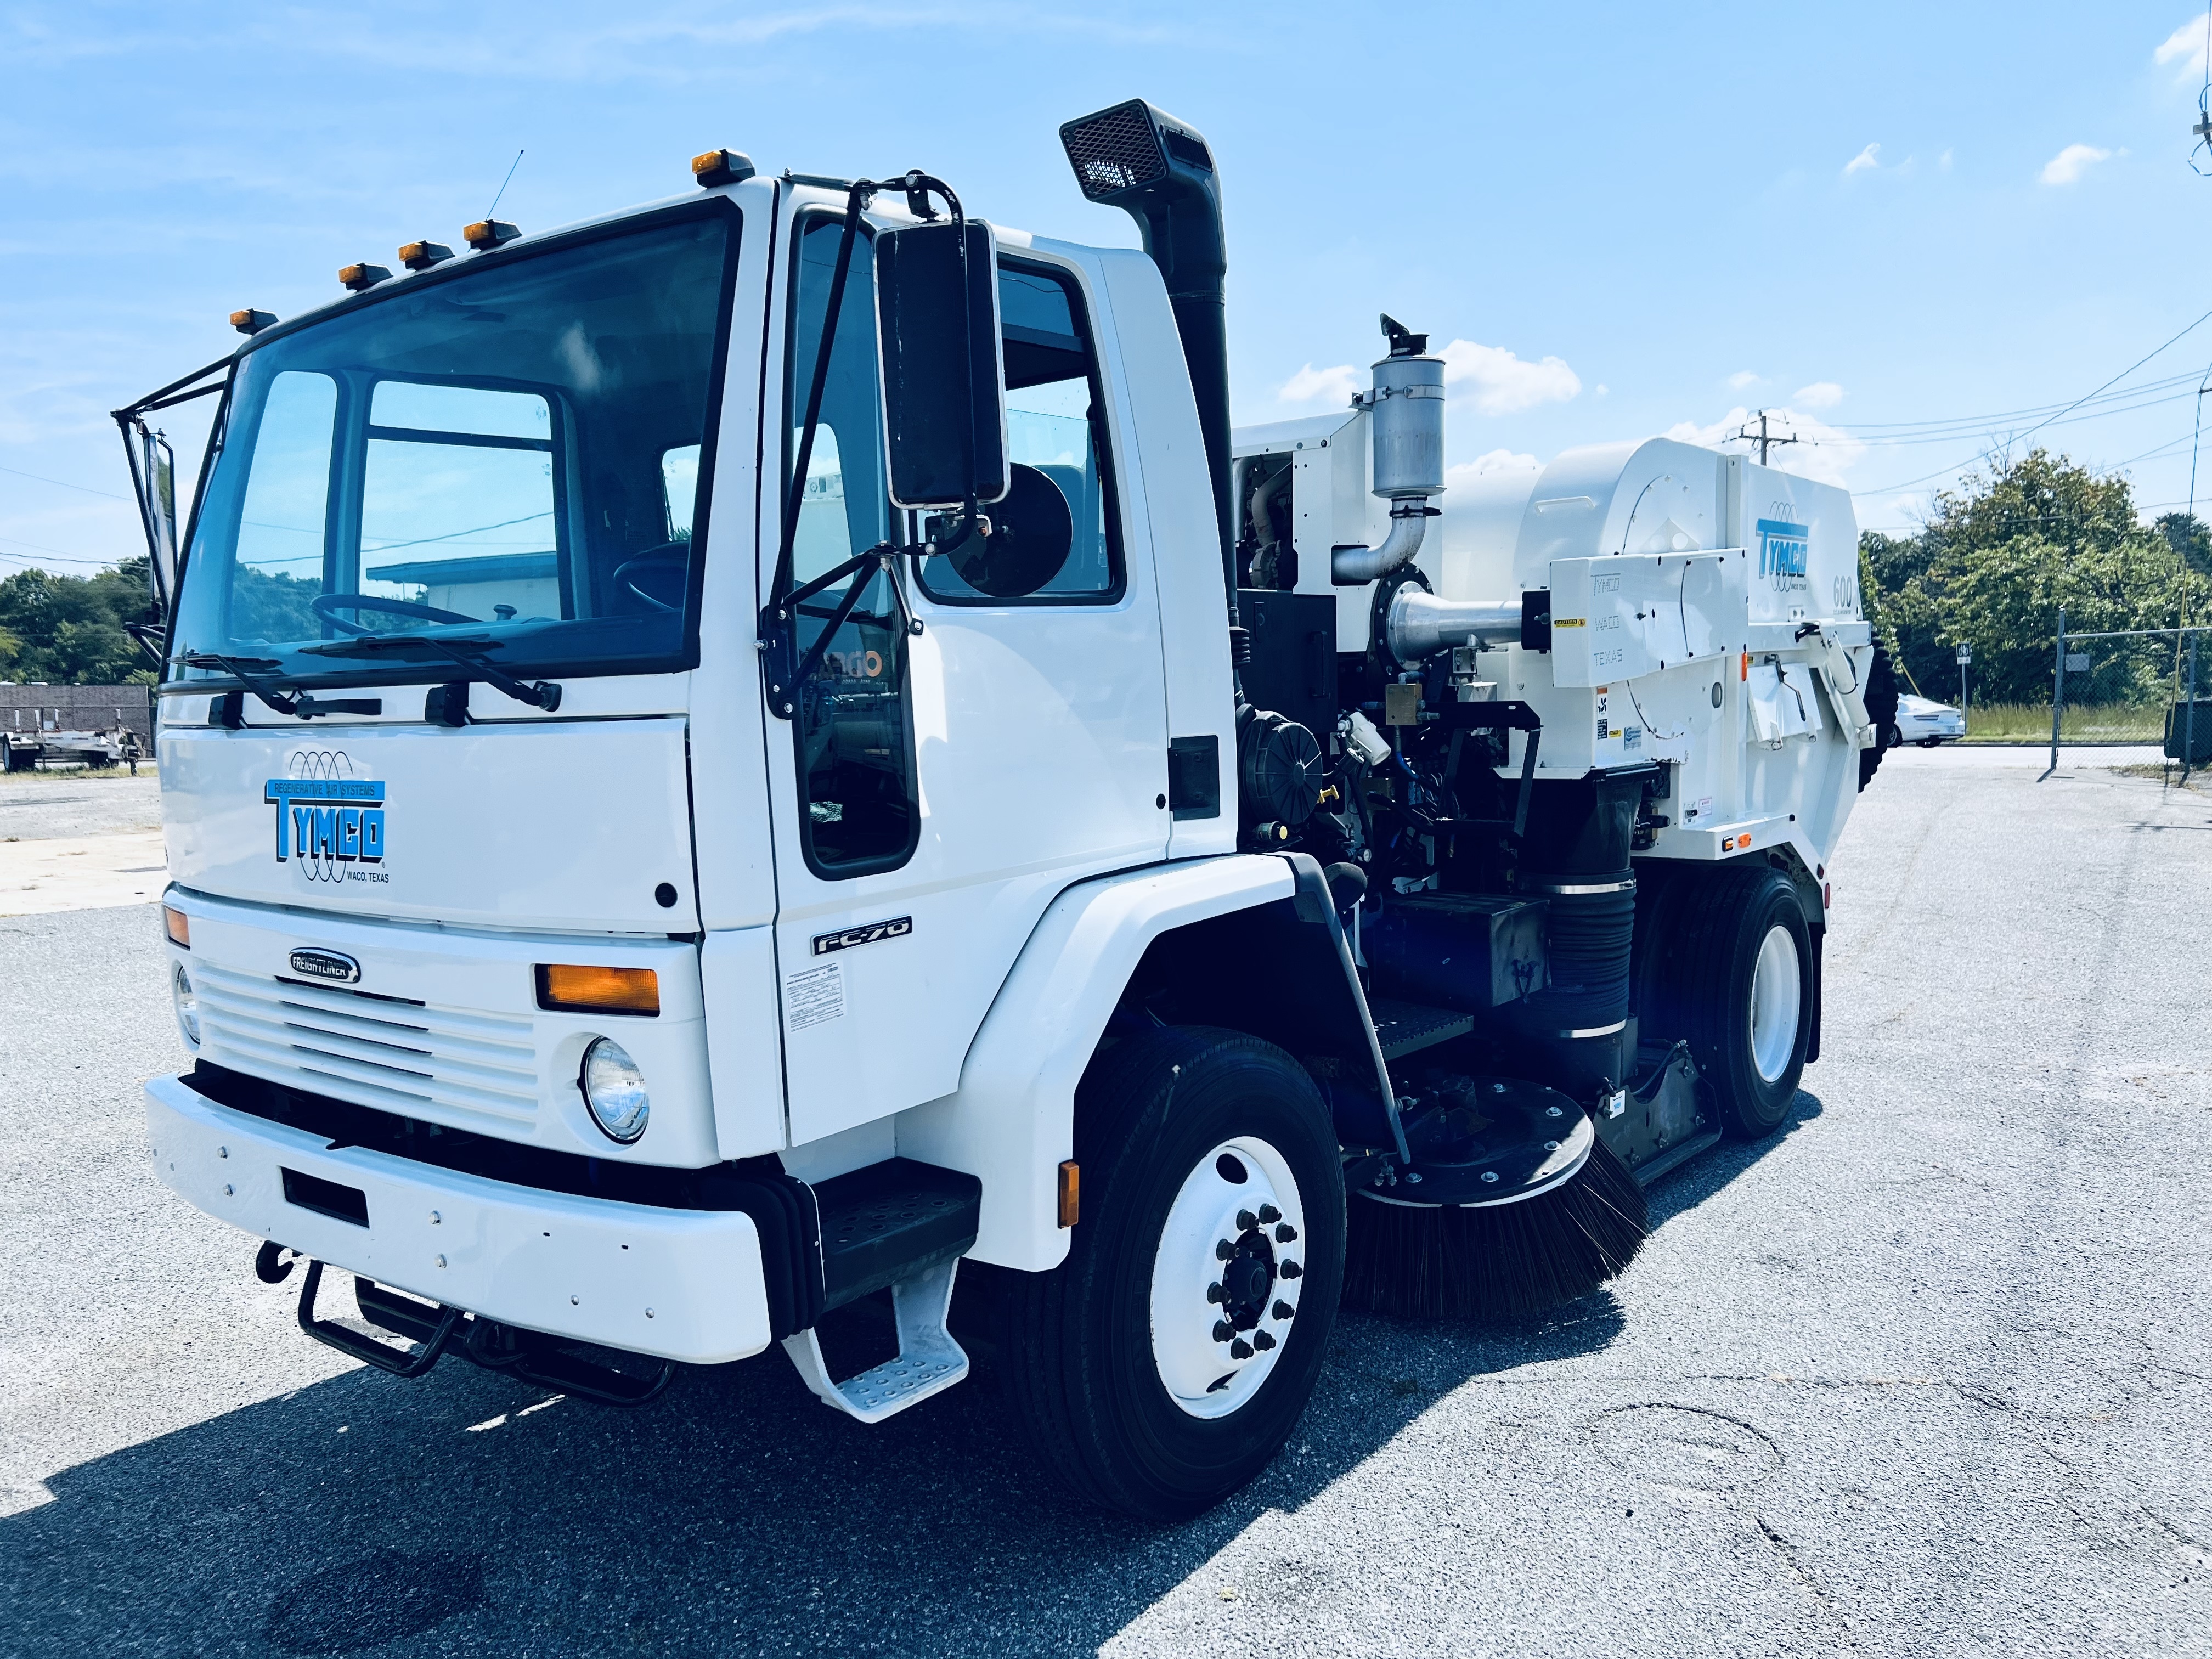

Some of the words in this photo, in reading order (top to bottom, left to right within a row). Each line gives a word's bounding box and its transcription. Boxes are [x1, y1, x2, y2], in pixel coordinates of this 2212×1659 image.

[1756, 518, 1808, 579] TYMCO
[1590, 572, 1621, 596] TYMCO
[1833, 575, 1852, 608] 600
[1595, 616, 1620, 632] WACO
[1593, 648, 1623, 667] TEXAS
[275, 783, 323, 795] REGENERATIVE
[326, 785, 338, 795] AIR
[341, 785, 375, 797] SYSTEMS
[264, 779, 386, 863] TYMCO
[347, 871, 368, 883] WACO,
[368, 872, 390, 883] TEXAS
[818, 919, 910, 953] FC-70
[292, 956, 346, 977] FREIGHTLINER
